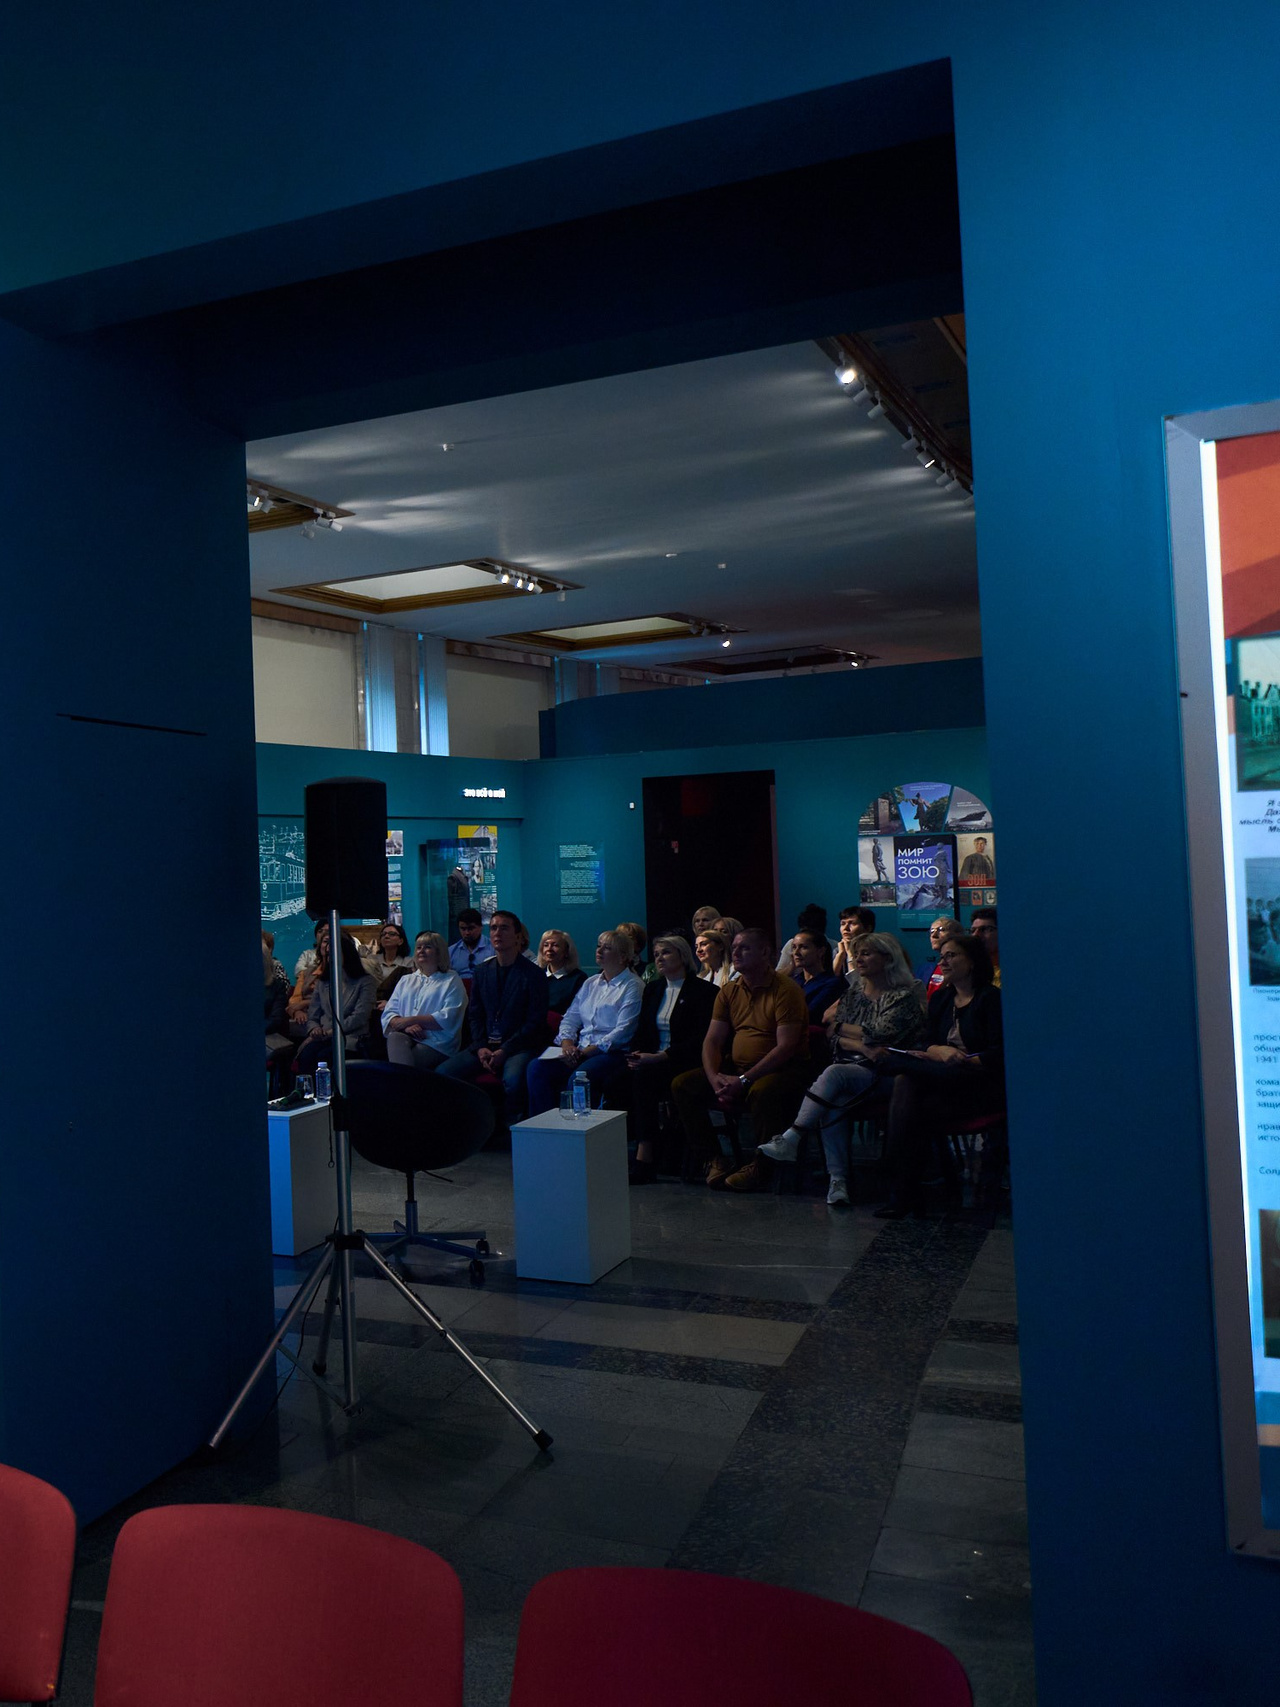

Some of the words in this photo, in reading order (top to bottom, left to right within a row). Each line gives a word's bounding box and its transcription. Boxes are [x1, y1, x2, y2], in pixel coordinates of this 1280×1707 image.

[1265, 808, 1280, 816] Да
[898, 847, 924, 858] МИР
[898, 865, 940, 879] ЗОЮ
